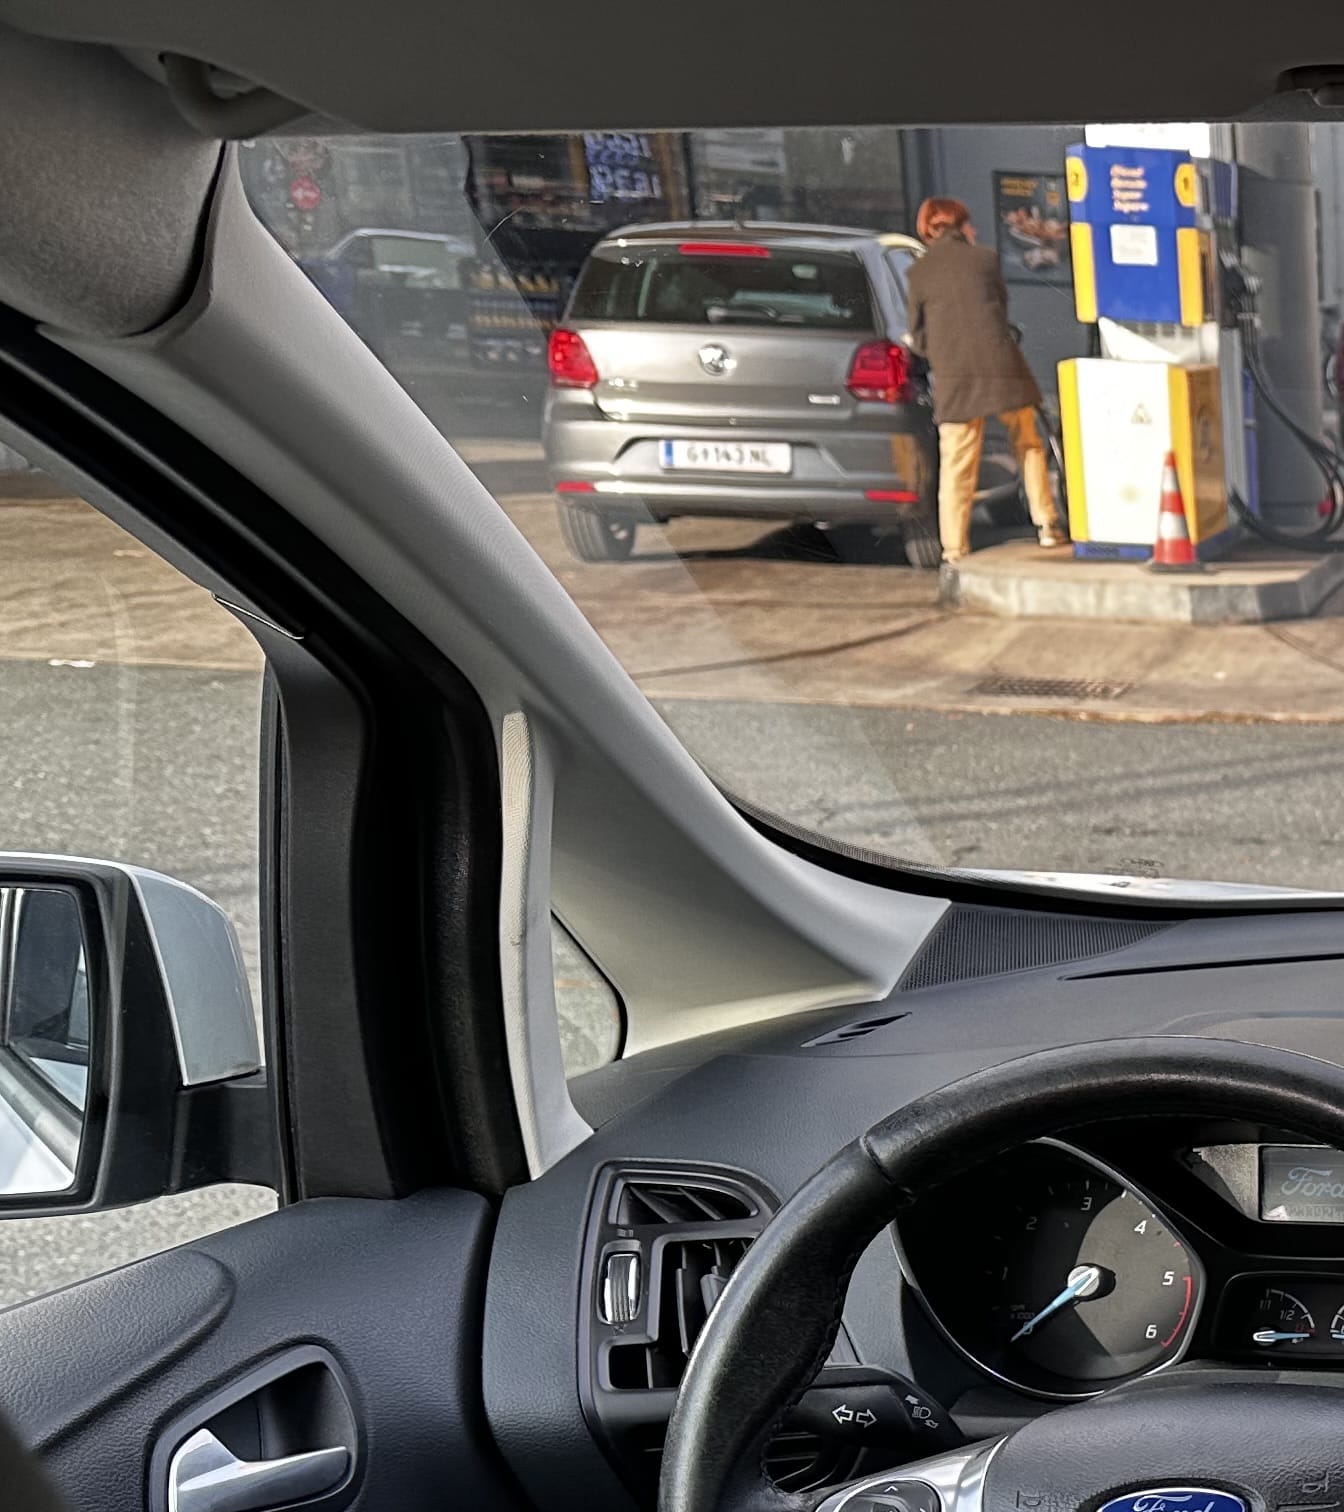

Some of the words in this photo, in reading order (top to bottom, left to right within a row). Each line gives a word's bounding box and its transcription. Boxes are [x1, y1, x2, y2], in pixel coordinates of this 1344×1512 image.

[1081, 1197, 1092, 1211] 3
[1026, 1216, 1038, 1231] 2
[1134, 1220, 1147, 1234] 4
[1163, 1271, 1175, 1285] 5
[1280, 1310, 1295, 1320] 1/2
[1146, 1325, 1158, 1339] 6
